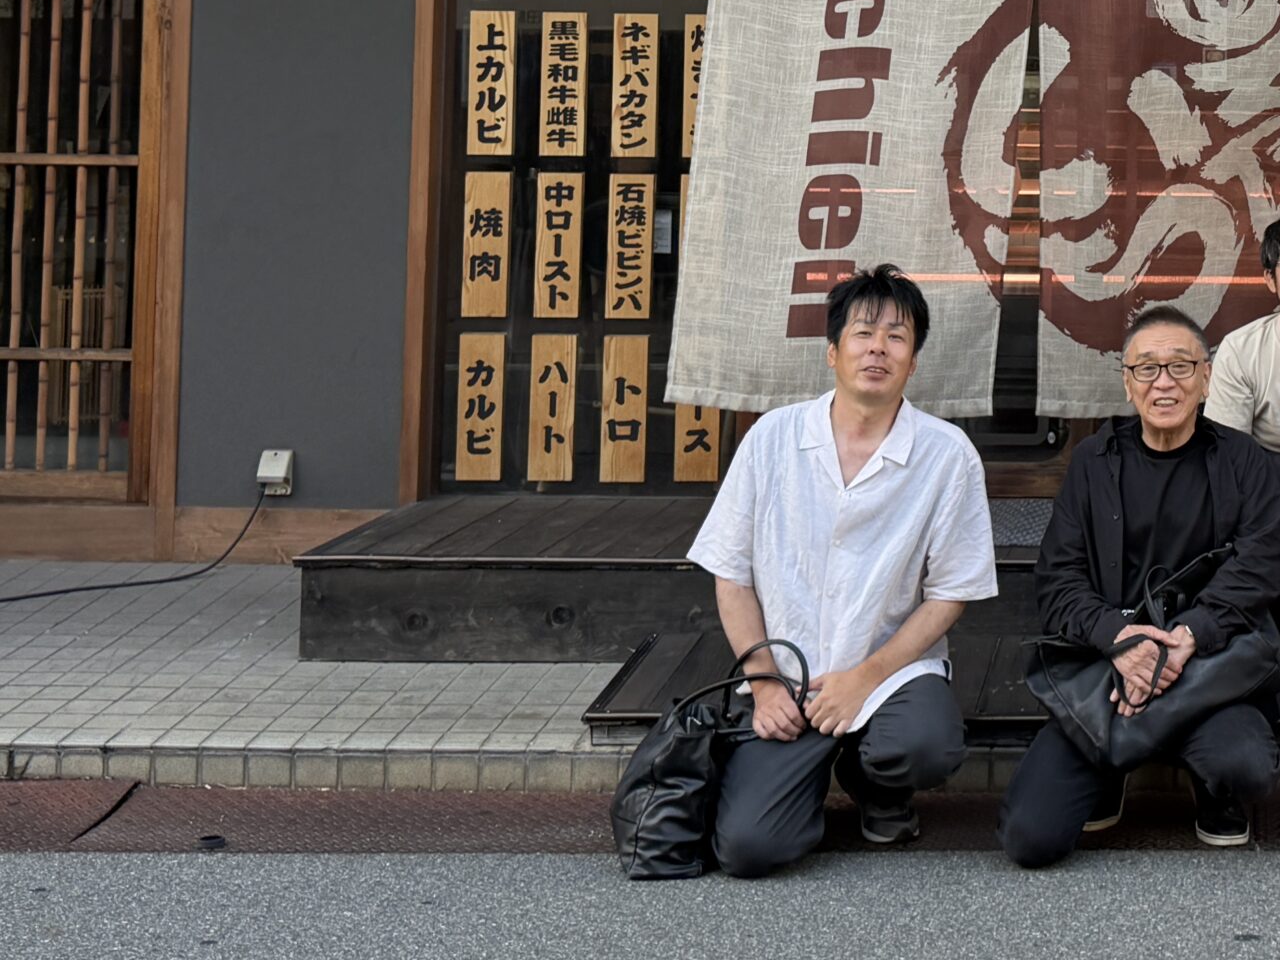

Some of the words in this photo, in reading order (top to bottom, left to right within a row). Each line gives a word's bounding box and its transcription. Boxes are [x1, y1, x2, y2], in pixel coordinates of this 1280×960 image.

[475, 23, 507, 143] 上カルビ
[547, 21, 580, 148] 黒毛和牛雌牛
[620, 22, 650, 149] ネギバカタン
[469, 208, 503, 282] 焼肉
[543, 182, 574, 310] 中ロースト
[613, 183, 646, 311] 石焼ビビンバ
[465, 360, 495, 455] カルビ
[539, 362, 568, 453] ハート
[607, 377, 641, 442] トロ
